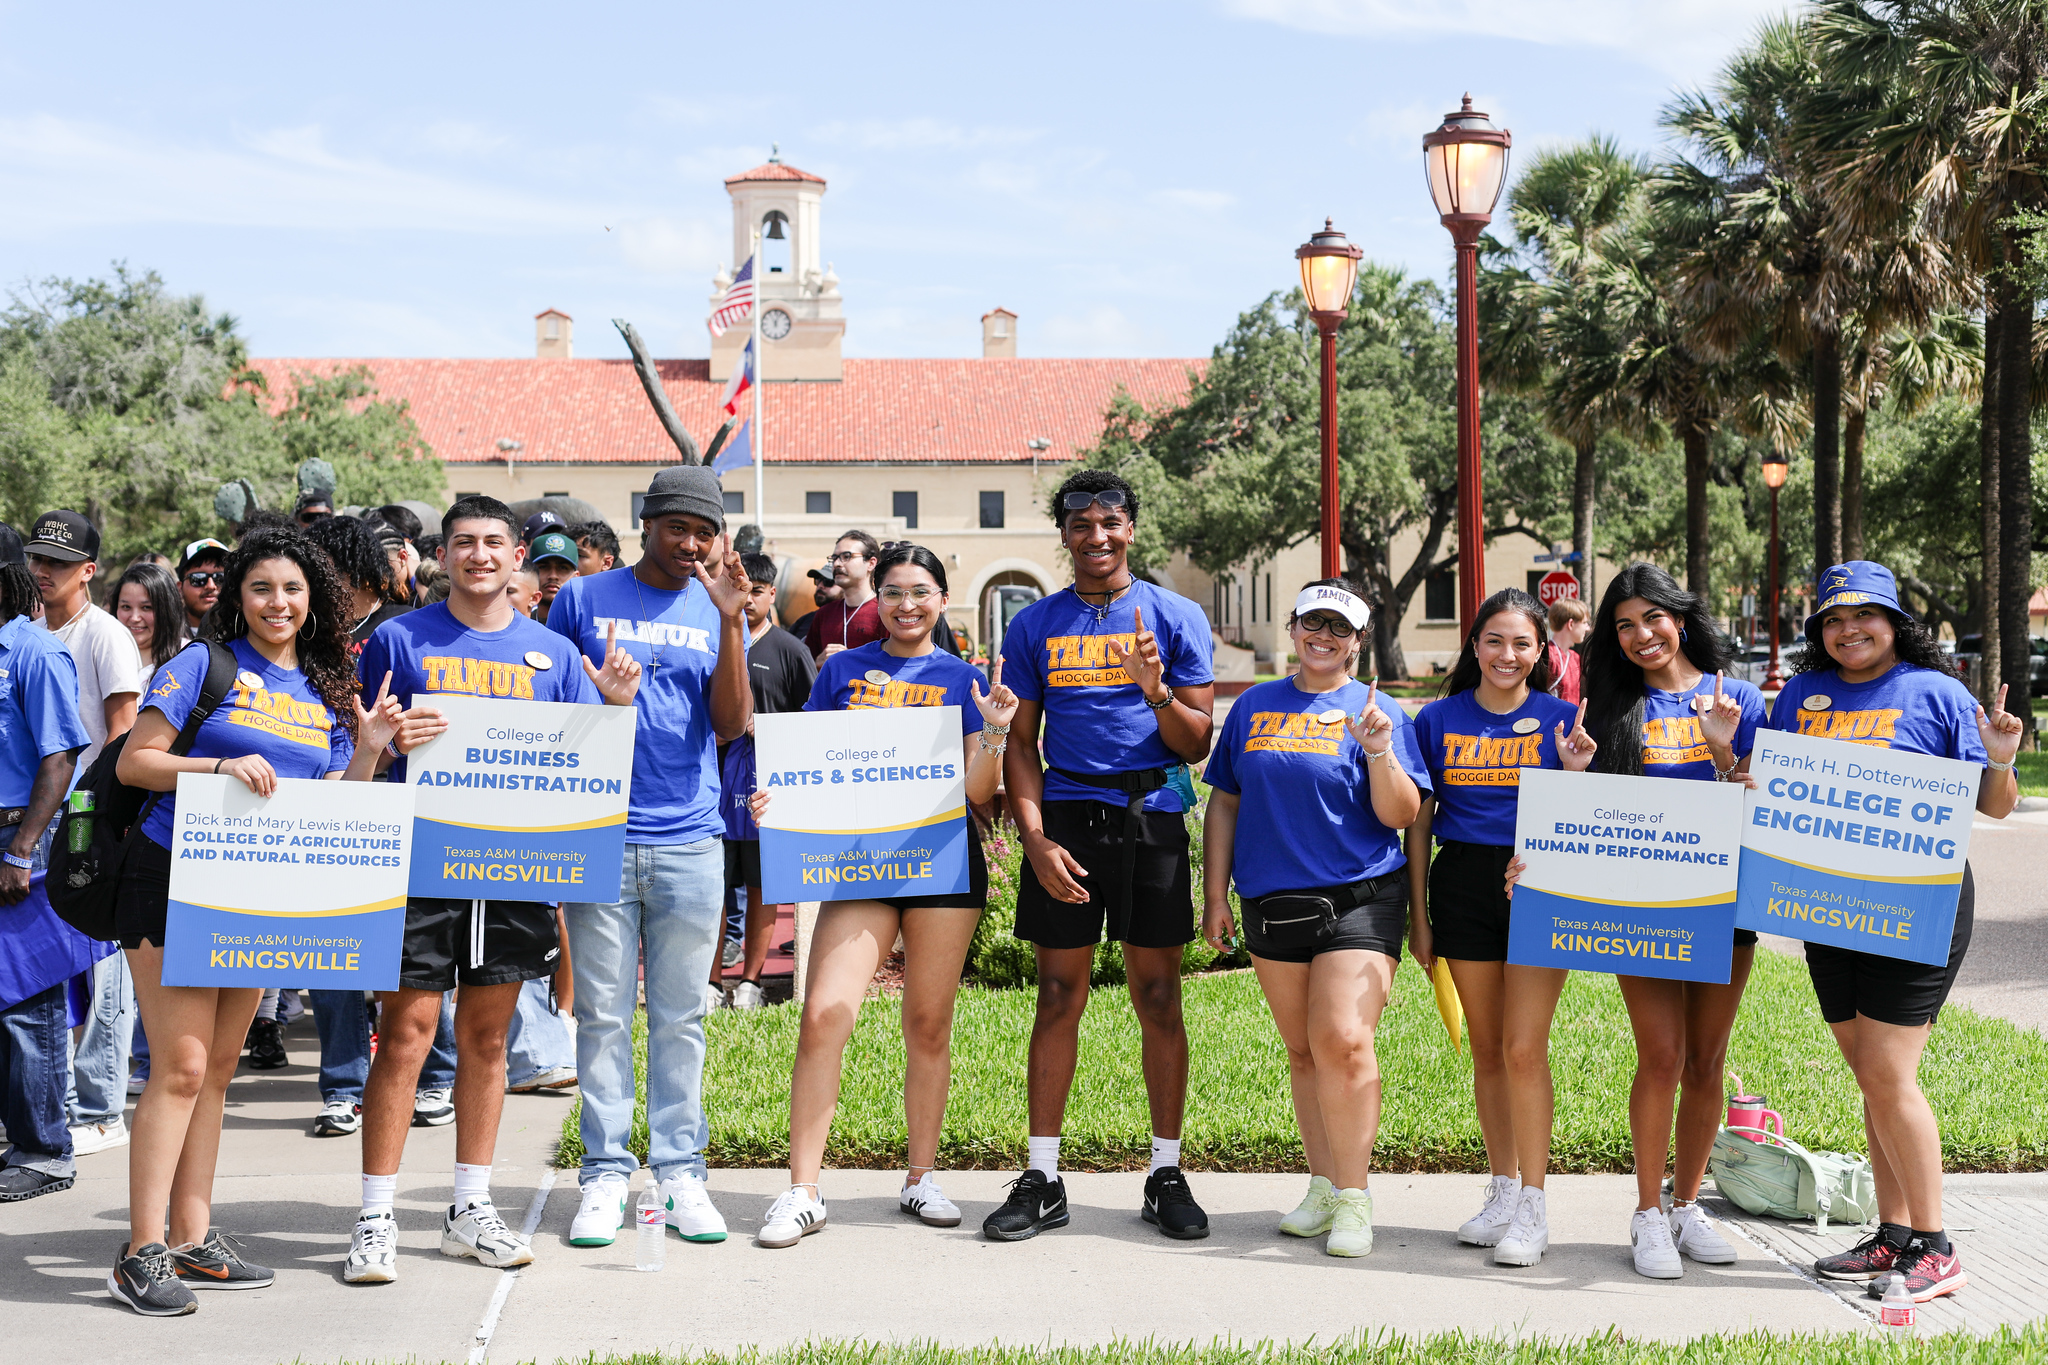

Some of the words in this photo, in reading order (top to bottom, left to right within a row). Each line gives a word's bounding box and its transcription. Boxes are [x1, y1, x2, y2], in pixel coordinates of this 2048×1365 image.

[37, 527, 62, 536] CATTLE
[62, 531, 73, 540] CO.
[44, 520, 69, 531] WBHC
[1316, 588, 1351, 607] TAMUK
[1542, 582, 1578, 600] STOP
[593, 616, 710, 654] TAMUK
[1046, 632, 1136, 669] TAMU
[422, 656, 536, 700] TAMUK
[1056, 672, 1102, 683] HOGGIE
[1105, 671, 1130, 682] DAY
[848, 678, 948, 708] TAMUK
[232, 678, 333, 732] TAMUK
[244, 713, 292, 736] HOGGIE
[296, 729, 324, 744] DAYS
[1797, 708, 1904, 739] TAMUK
[486, 728, 544, 744] College
[548, 730, 564, 742] of
[1252, 739, 1296, 749] HOGGIE
[1298, 738, 1329, 750] DAYS
[466, 748, 580, 768] BUSINESS
[825, 748, 879, 762] College
[882, 746, 896, 758] of
[1443, 733, 1544, 767] TAMUK
[1643, 751, 1690, 760] HOGGIE
[1693, 748, 1712, 757] DA
[417, 770, 622, 794] ADMINISTRATION
[767, 770, 824, 787] ARTS
[830, 768, 845, 784] &
[852, 764, 956, 783] SCIENCES
[1451, 772, 1494, 782] HOGGIE
[1498, 772, 1520, 781] DAY
[1760, 748, 1816, 772] Frank
[1822, 758, 1840, 776] H.
[1846, 763, 1970, 798] Dotterweich
[1767, 777, 1902, 818] COLLEGE
[1910, 802, 1954, 826] OF
[185, 813, 220, 826] Dick
[224, 815, 253, 828] and
[258, 816, 295, 832] Mary
[300, 818, 340, 832] Lewis
[345, 820, 401, 836] Kleberg
[1594, 808, 1646, 824] College
[1649, 812, 1664, 824] of
[182, 830, 258, 845] COLLEGE
[262, 834, 285, 846] OF
[290, 836, 402, 850] AGRICULTURE
[1554, 822, 1657, 842] EDUCATION
[1661, 831, 1701, 845] AND
[1752, 806, 1957, 860] ENGINEERING
[180, 848, 217, 860] AND
[222, 850, 300, 864] NATURAL
[305, 853, 401, 867] RESOURCES
[444, 846, 481, 858] Texas
[484, 848, 516, 860] A&M
[520, 849, 587, 864] University
[800, 852, 835, 864] Texas
[838, 850, 868, 862] A&M
[870, 847, 933, 860] University
[1524, 838, 1590, 855] HUMAN
[1594, 843, 1730, 866] PERFORMANCE
[442, 862, 585, 884] KINGSVILLE
[802, 861, 933, 885] KINGSVILLE
[1770, 881, 1808, 898] Texas
[1810, 889, 1843, 905] A&M
[1846, 896, 1916, 920] University
[1552, 916, 1588, 930] Texas
[1591, 920, 1623, 934] A&M
[1627, 924, 1695, 942] University
[1766, 898, 1912, 941] KINGSVILLE
[211, 932, 251, 945] Texas
[254, 934, 288, 946] A&M
[292, 934, 363, 950] University
[1551, 932, 1693, 962] KINGSVILLE
[210, 950, 360, 971] KINGSVILLE
